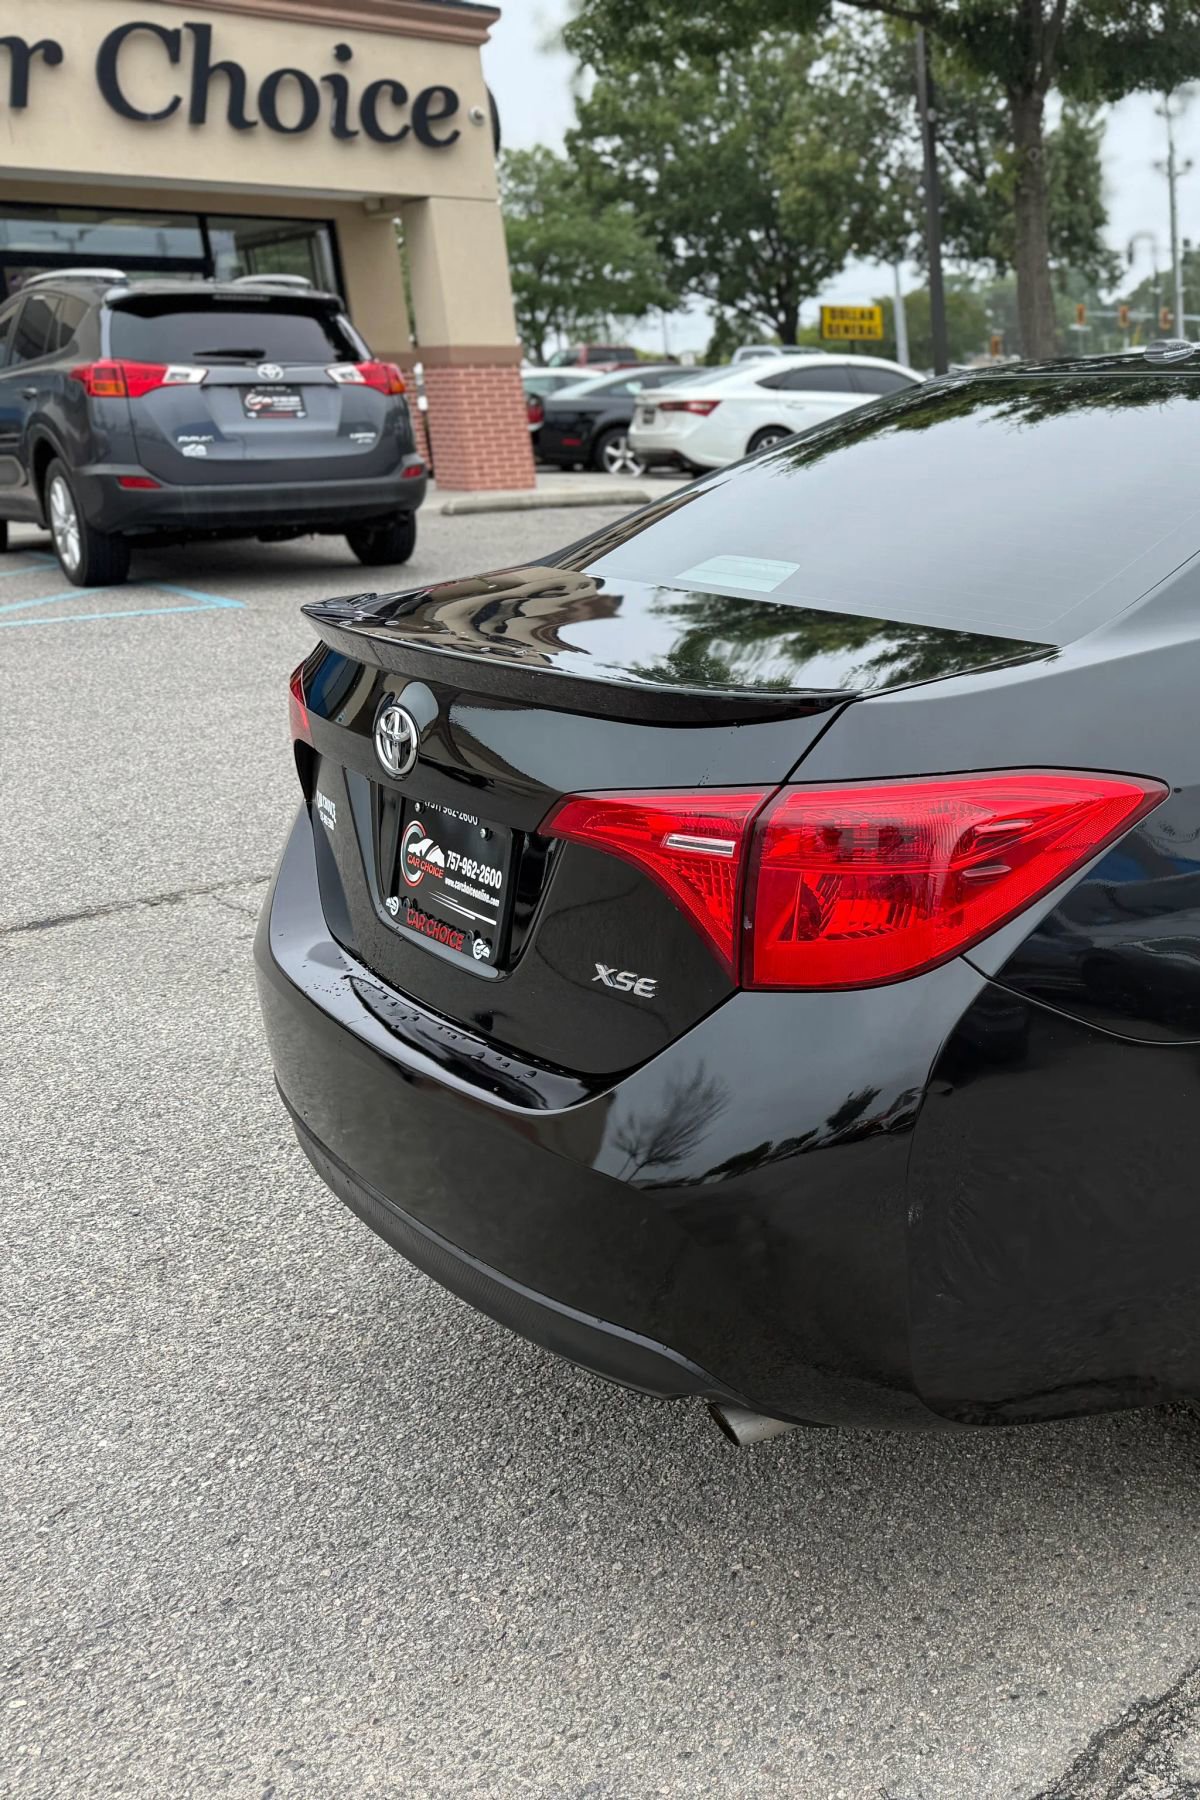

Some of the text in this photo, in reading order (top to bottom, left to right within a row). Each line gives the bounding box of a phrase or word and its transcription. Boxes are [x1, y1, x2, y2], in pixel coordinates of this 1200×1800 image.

[95, 21, 461, 148] Choice
[407, 854, 445, 879] CAR CHOICE
[446, 850, 502, 889] 757-962-2600
[445, 877, 500, 907] www.carchoiceonline.com
[407, 908, 465, 951] CAR CHOICE
[591, 963, 658, 998] XSE
